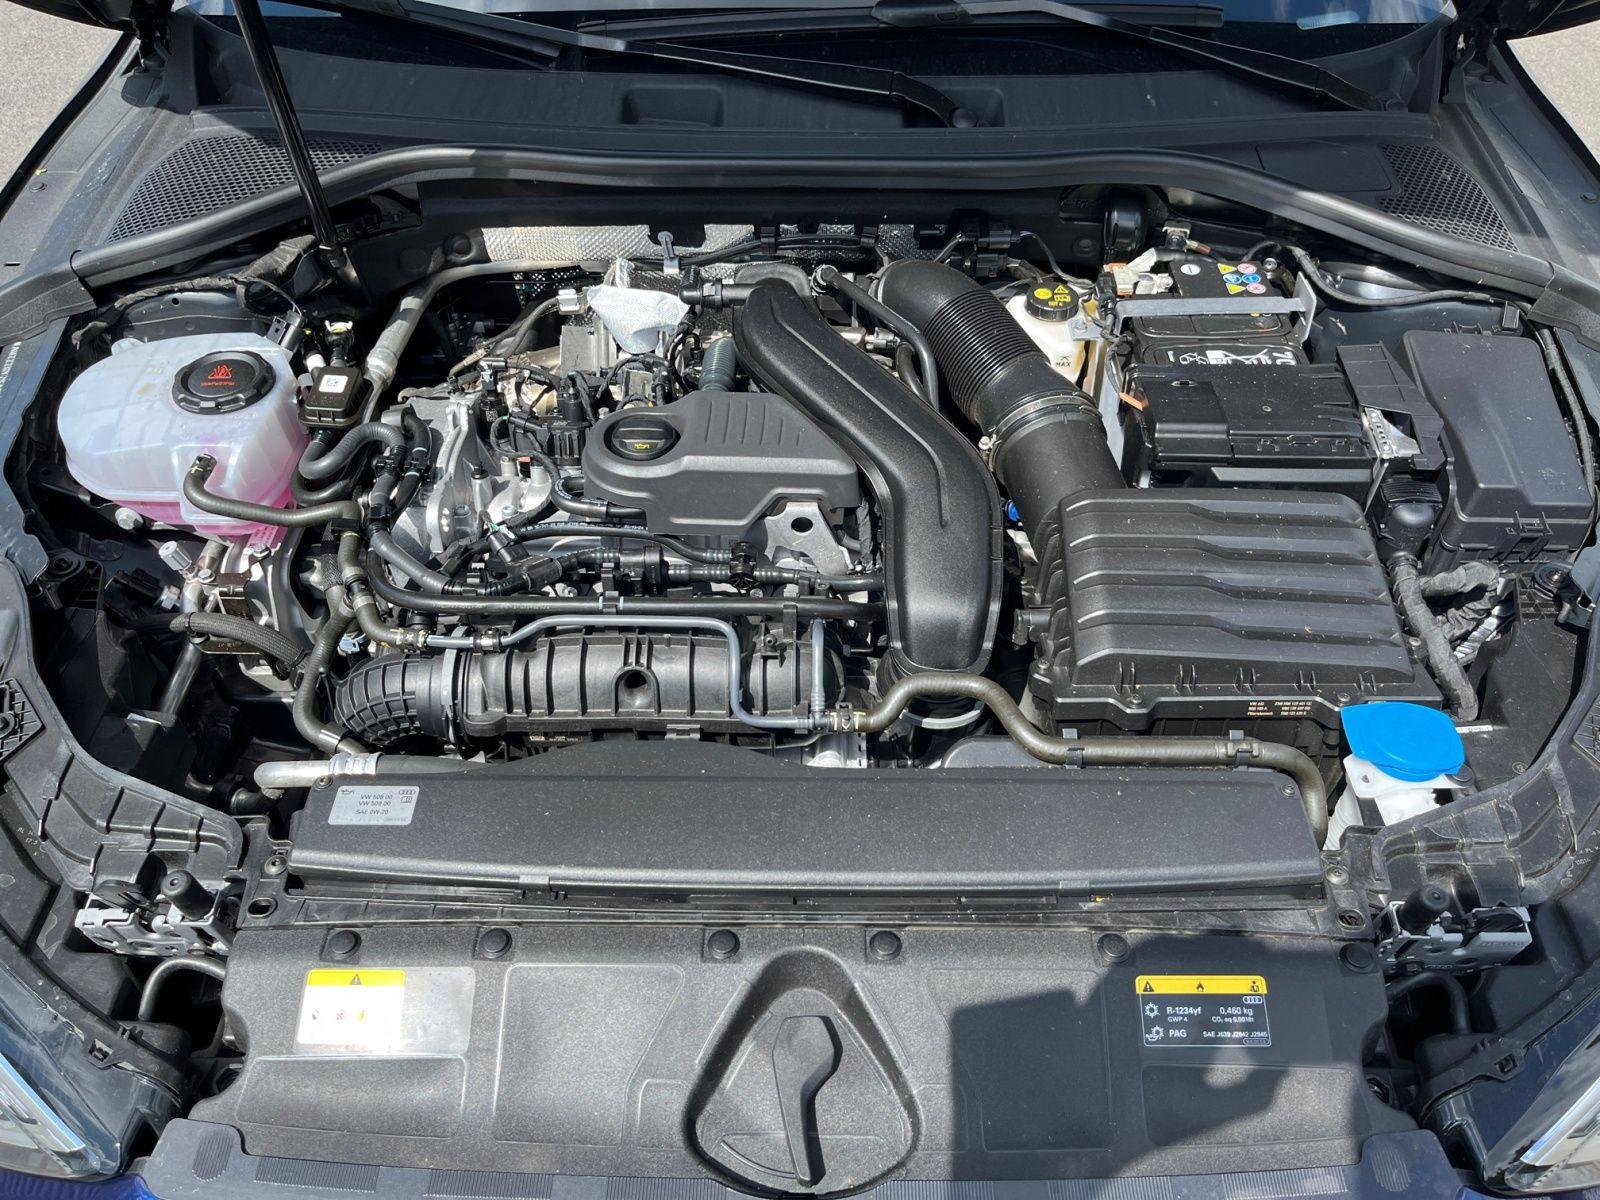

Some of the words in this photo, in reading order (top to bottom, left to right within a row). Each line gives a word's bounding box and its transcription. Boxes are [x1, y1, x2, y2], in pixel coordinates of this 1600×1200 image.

[1166, 1006, 1202, 1016] R-1234yf
[1219, 1006, 1242, 1015] 0,460
[1243, 1006, 1253, 1016] kg
[1169, 1029, 1187, 1038] PAG
